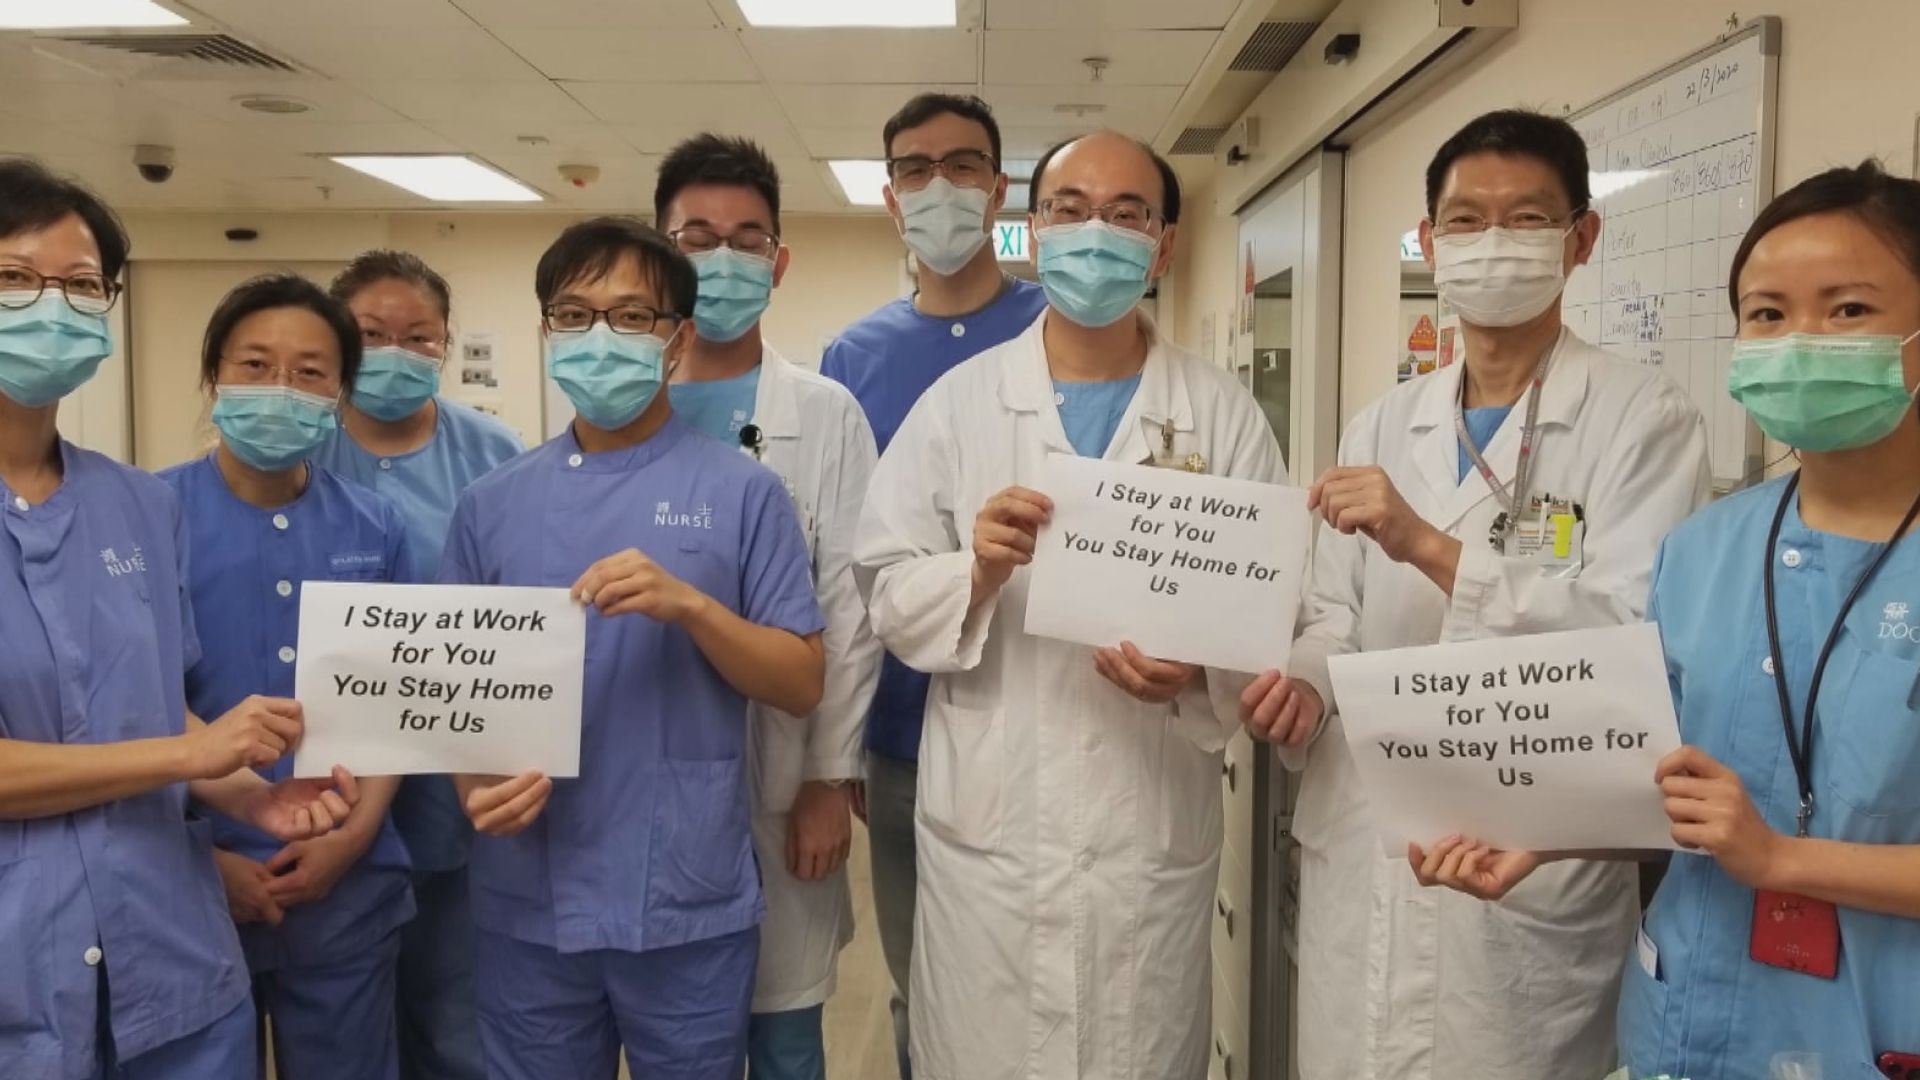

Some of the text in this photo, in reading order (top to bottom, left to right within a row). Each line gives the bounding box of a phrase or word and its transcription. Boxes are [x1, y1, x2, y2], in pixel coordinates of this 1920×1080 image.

[1686, 63, 1739, 104] 22/3/2020
[995, 225, 1029, 256] XI
[1095, 481, 1260, 522] I Stay at Work
[654, 513, 713, 530] NURSE
[1130, 514, 1216, 544] for You
[1064, 531, 1281, 582] You Stay Home for
[1149, 574, 1179, 596] Us
[344, 605, 547, 635] I Stay at Work
[391, 640, 497, 666] for You
[333, 673, 554, 705] You Stay Home
[1394, 658, 1595, 697] I Stay at Work
[399, 708, 485, 734] for Us
[1446, 700, 1550, 727] for You
[1377, 728, 1649, 762] You Stay Home for
[1497, 767, 1534, 787] Us
